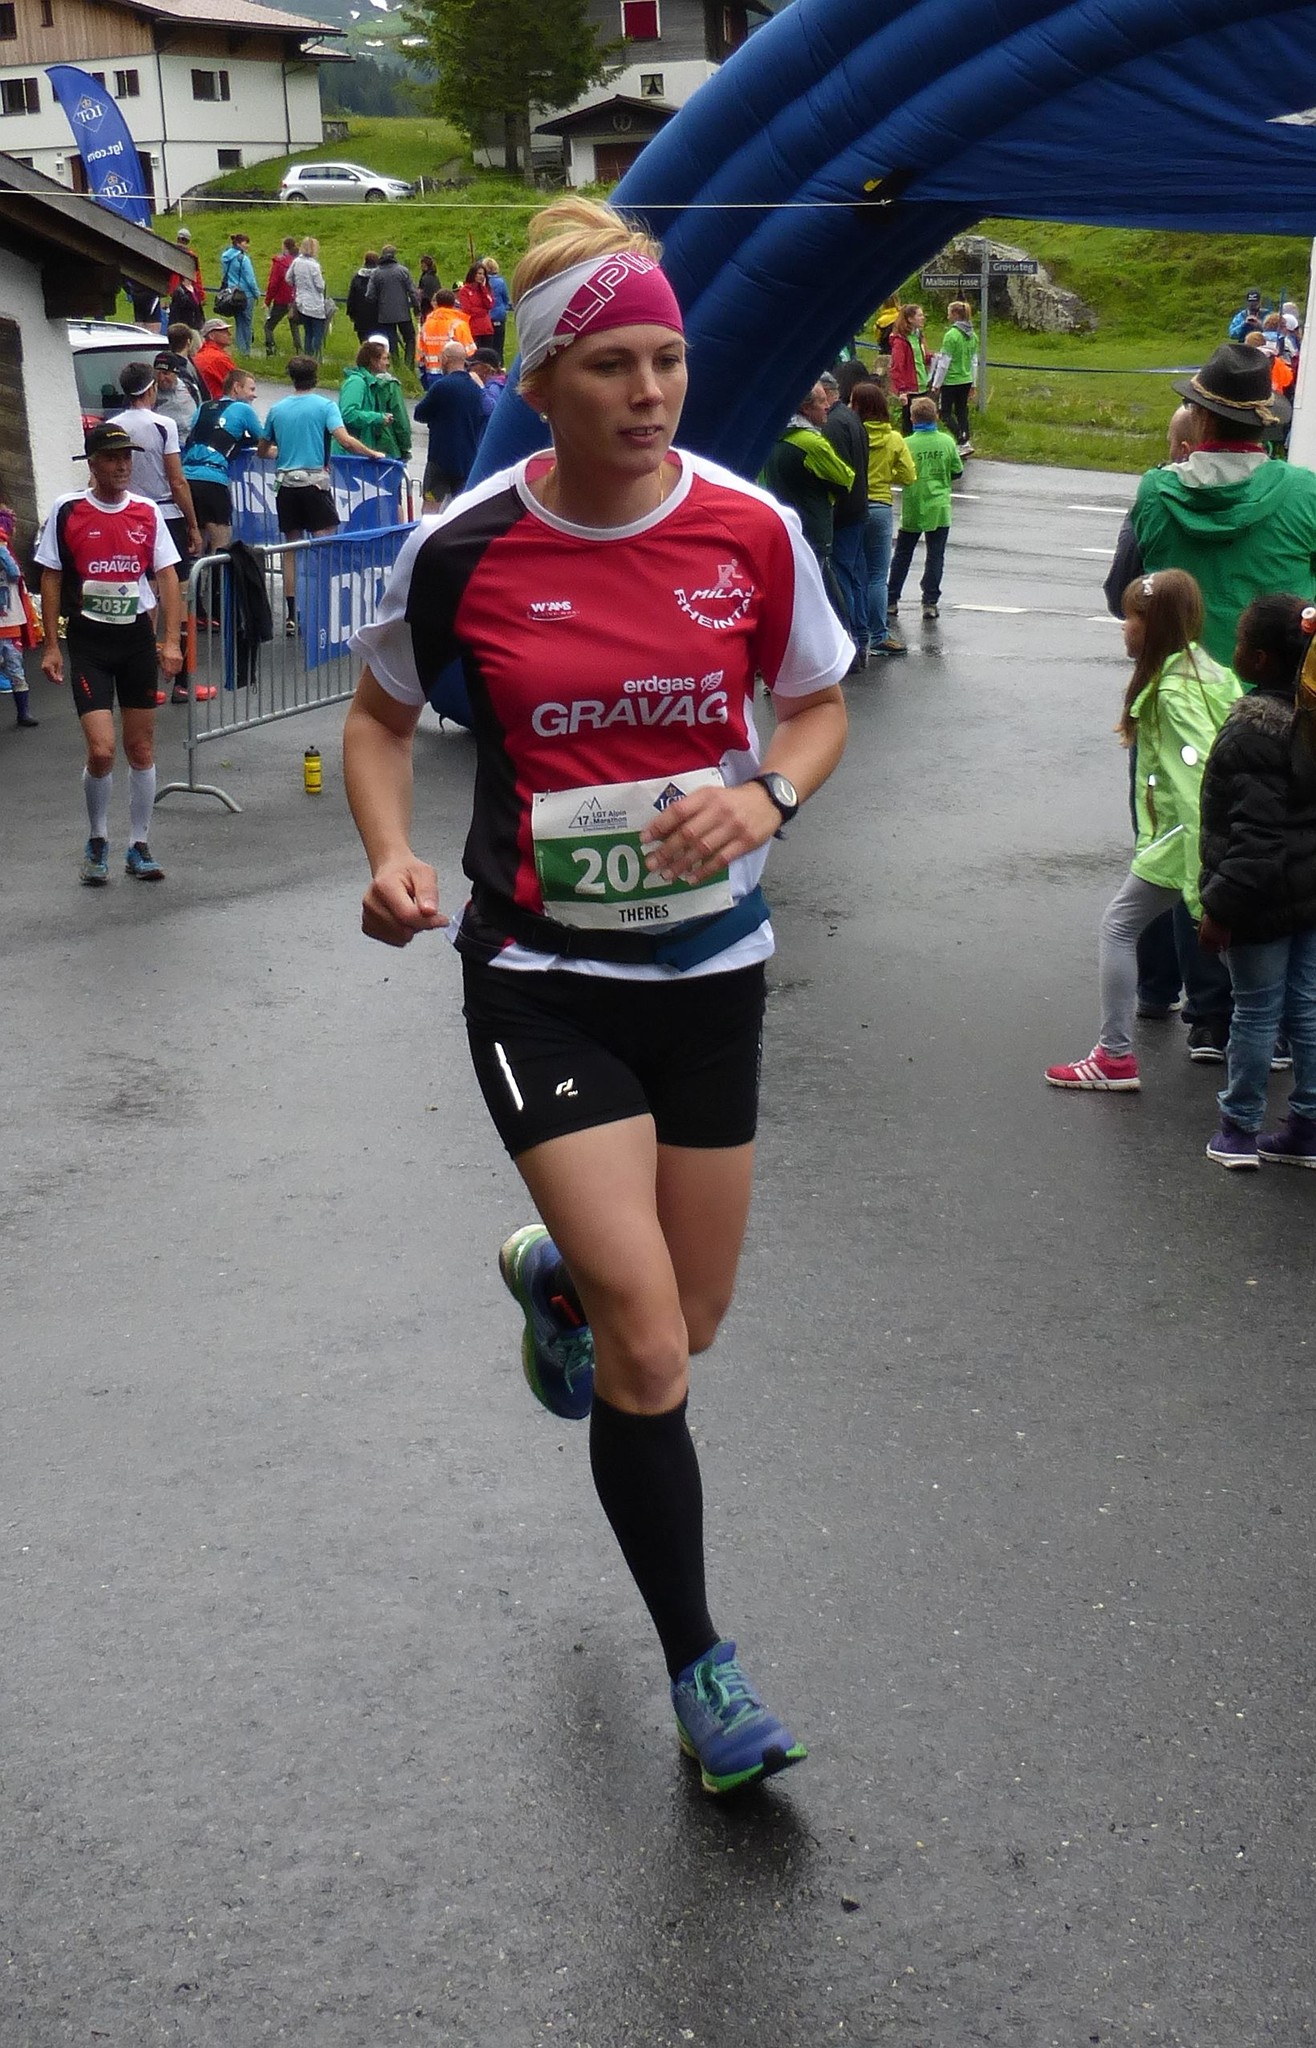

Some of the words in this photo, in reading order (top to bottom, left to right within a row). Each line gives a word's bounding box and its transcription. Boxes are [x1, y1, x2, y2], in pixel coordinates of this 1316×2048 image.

[917, 450, 944, 461] STAFF
[88, 560, 141, 574] GRAVAG
[91, 598, 132, 614] 2037
[623, 675, 696, 694] erdgas
[531, 691, 729, 738] GRAVAG
[593, 816, 628, 825] Marathon
[618, 904, 669, 923] THERES
